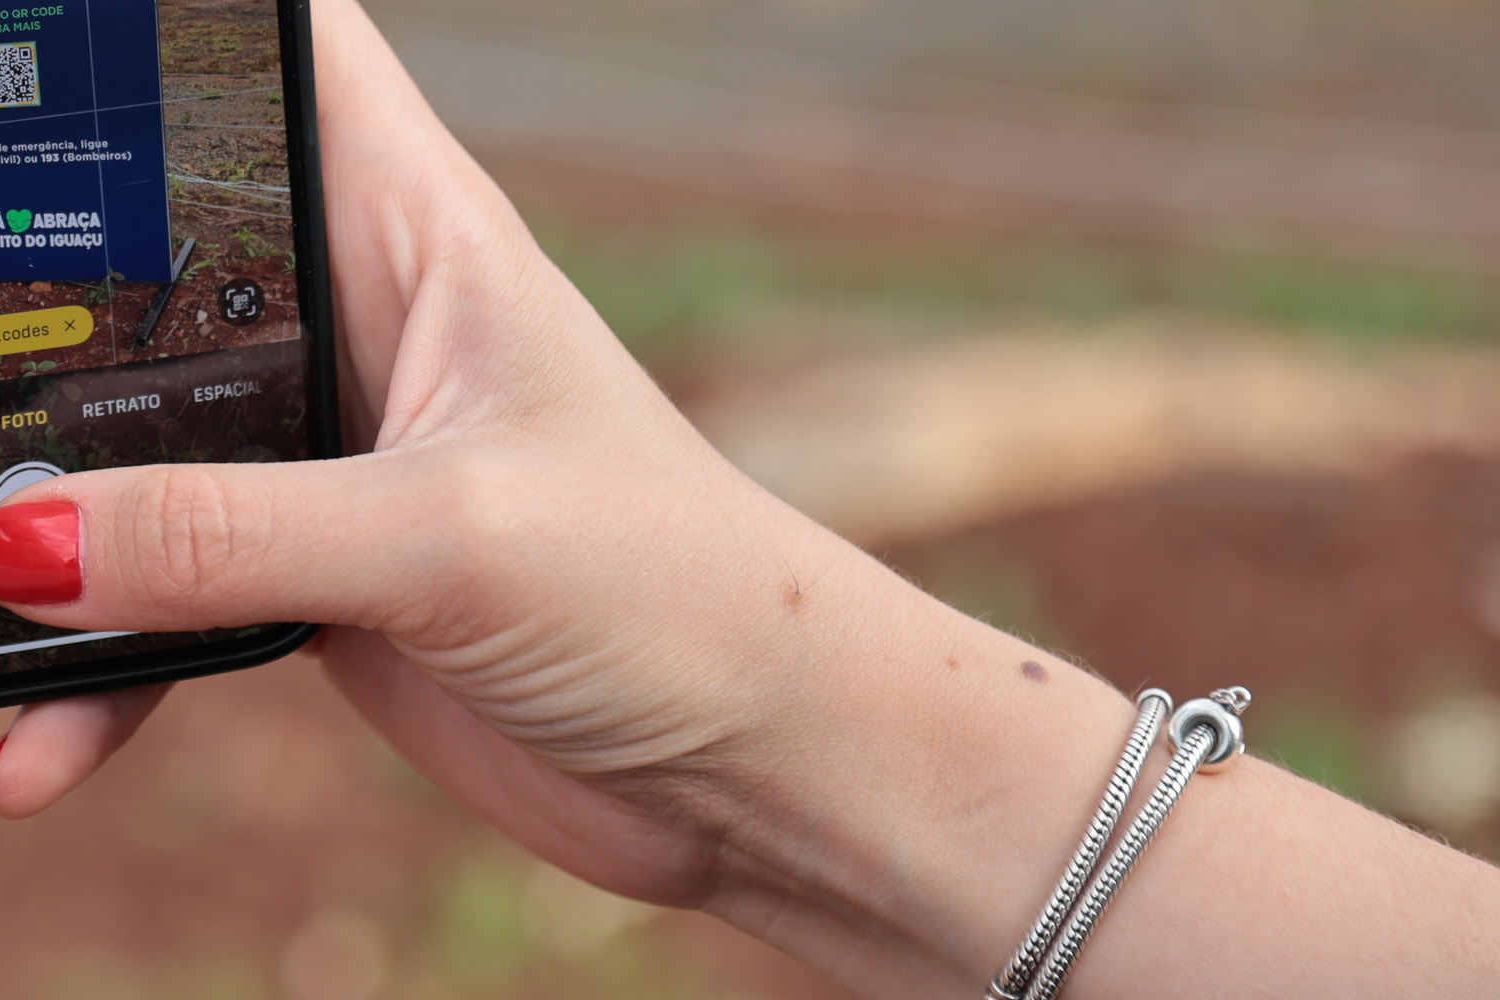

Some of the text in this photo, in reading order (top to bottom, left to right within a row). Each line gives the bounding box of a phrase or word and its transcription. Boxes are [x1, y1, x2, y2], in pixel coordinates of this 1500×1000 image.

[0, 10, 9, 20] O
[12, 8, 28, 19] QR
[31, 5, 64, 17] CODE
[13, 21, 41, 32] MAIS
[11, 140, 78, 153] emergência,
[80, 139, 108, 152] ligue
[24, 155, 38, 163] ou
[41, 153, 59, 163] 193
[62, 150, 132, 164] (Bombeiros)
[33, 212, 101, 231] ABRAÇA
[25, 233, 46, 248] DO
[49, 233, 103, 250] IGUAÇU
[1, 410, 48, 431] FOTO
[82, 394, 161, 418] RETRATO
[194, 380, 262, 403] ESPACIAL
